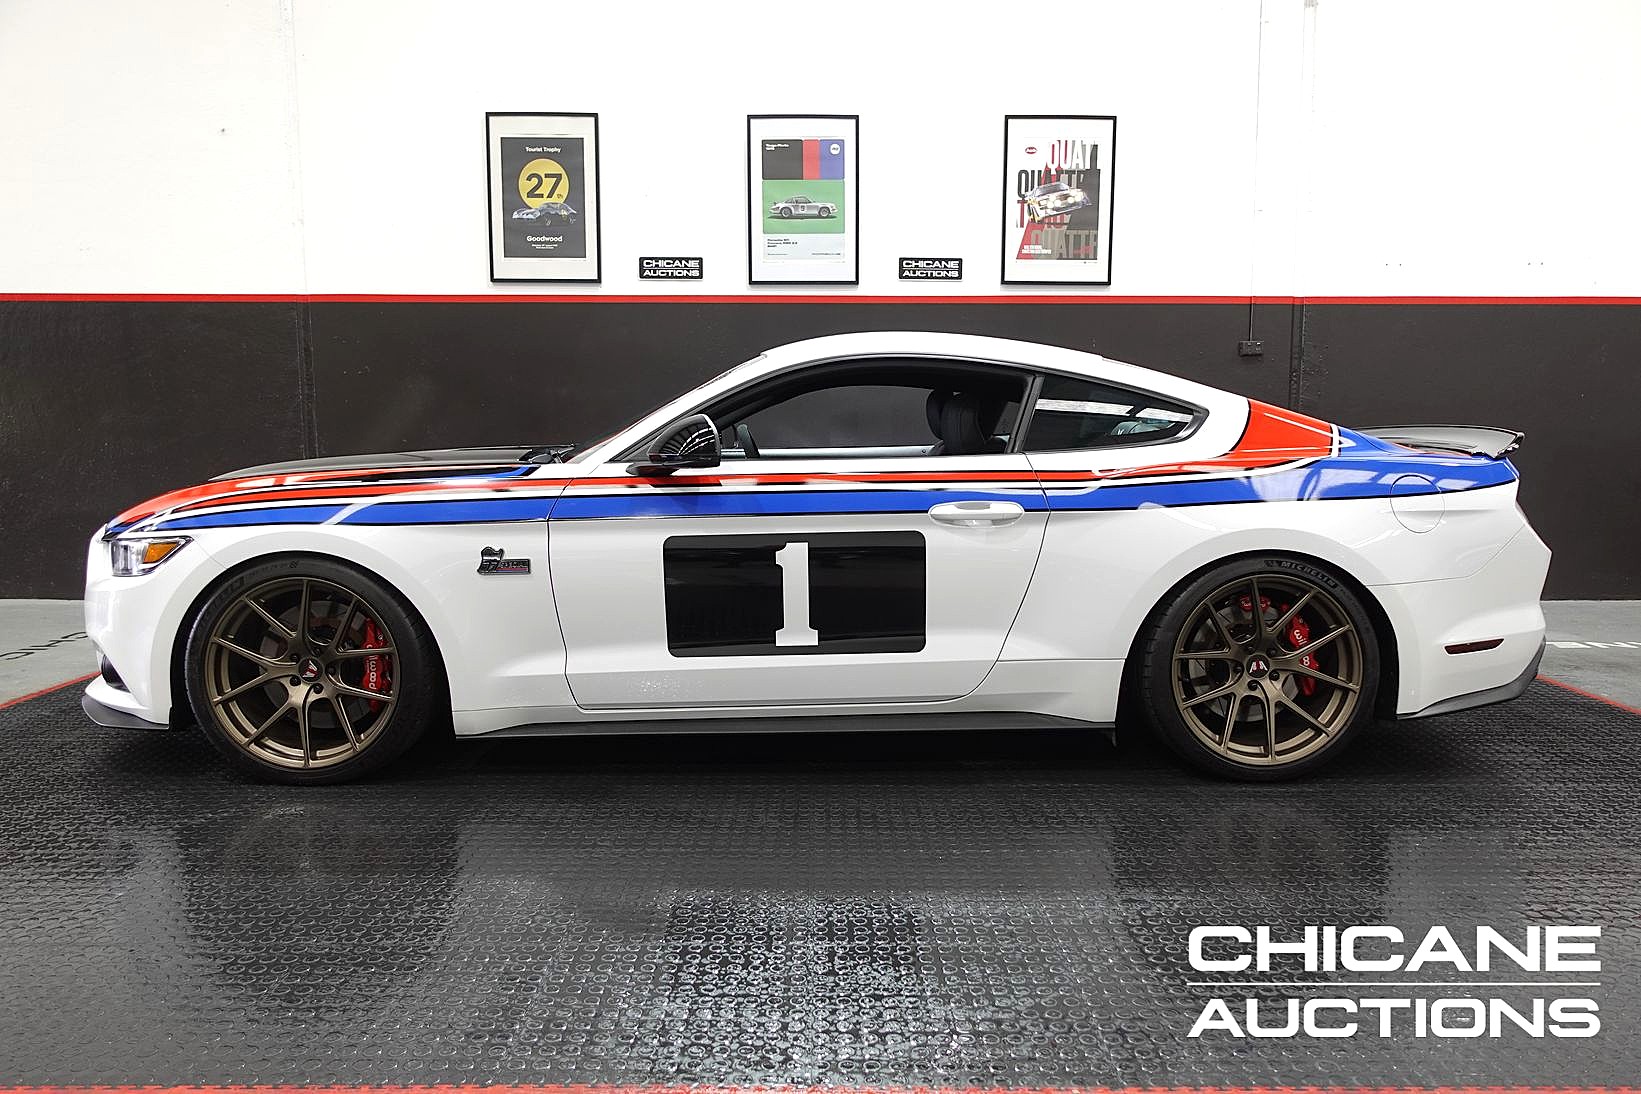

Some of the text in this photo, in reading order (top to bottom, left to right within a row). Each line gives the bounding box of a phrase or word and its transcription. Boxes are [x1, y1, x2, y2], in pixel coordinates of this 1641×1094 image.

[526, 235, 563, 243] Goodwood
[643, 259, 700, 268] CHICANE
[902, 260, 960, 269] CHICANE
[643, 269, 700, 277] AUCTIONS
[902, 270, 960, 278] AUCTIONS
[1280, 560, 1339, 589] MICHELIN
[775, 541, 819, 647] 1
